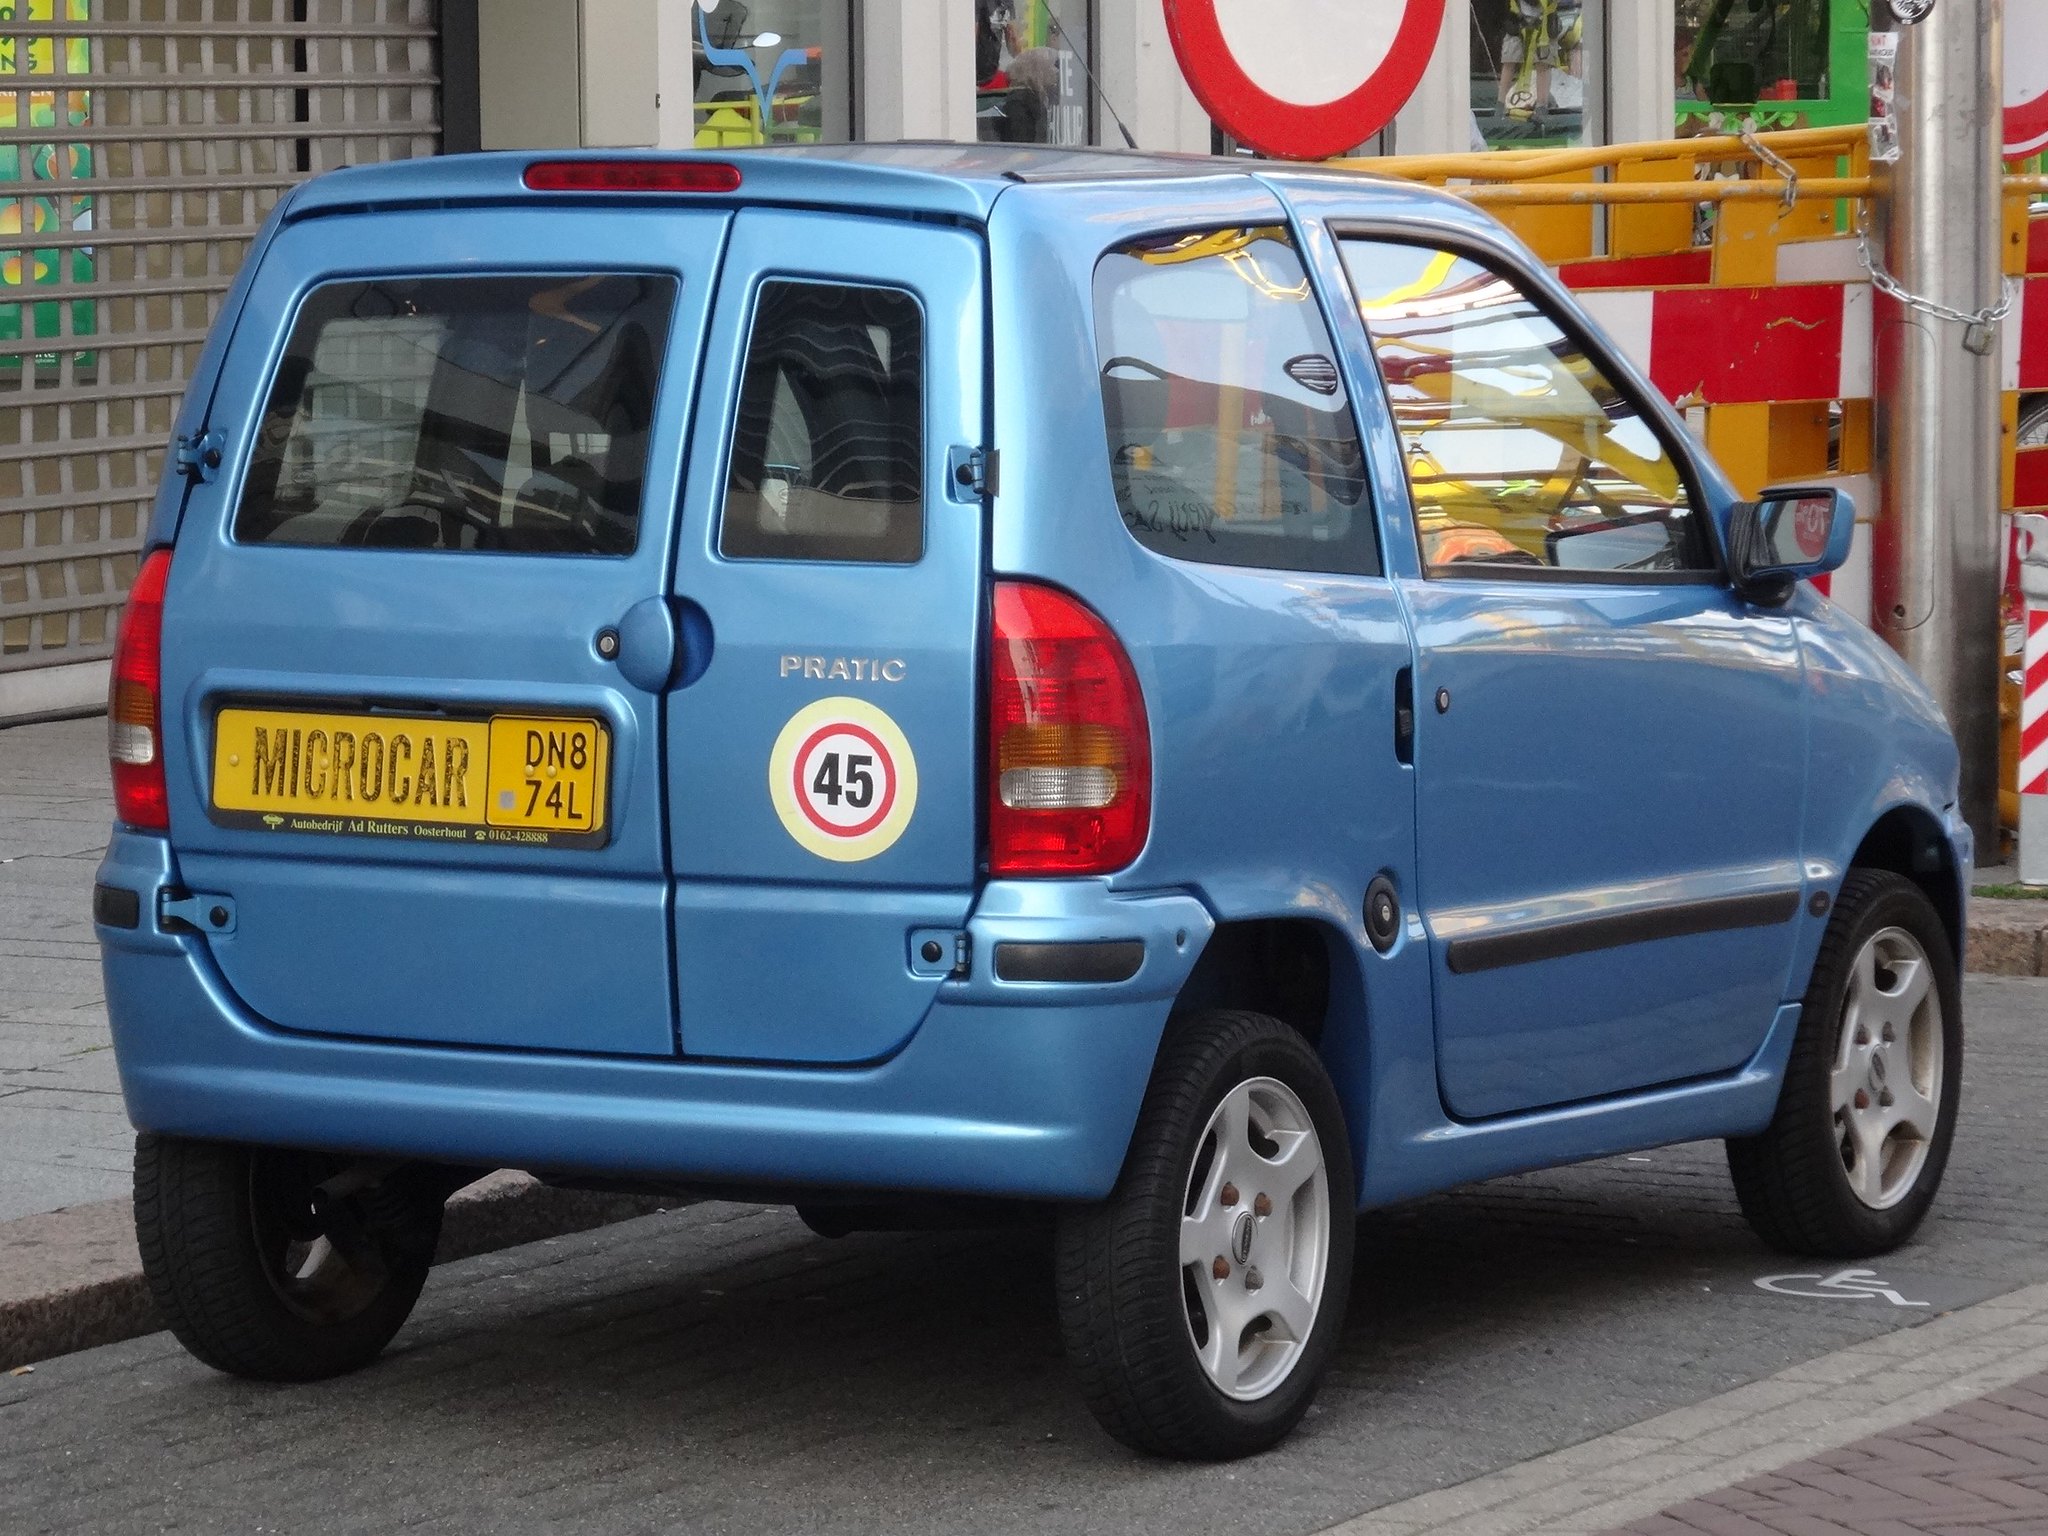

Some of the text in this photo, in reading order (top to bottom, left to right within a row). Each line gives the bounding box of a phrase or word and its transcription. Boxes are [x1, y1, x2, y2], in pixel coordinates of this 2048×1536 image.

[1058, 49, 1074, 97] TE
[779, 655, 907, 682] PRATIC
[252, 726, 470, 808] MICROCAR
[526, 730, 587, 770] DN8
[524, 779, 583, 820] 74L
[813, 752, 874, 809] 45
[290, 818, 549, 843] Autobedrijf Ad Rutters Oosterhout 0162-428888
